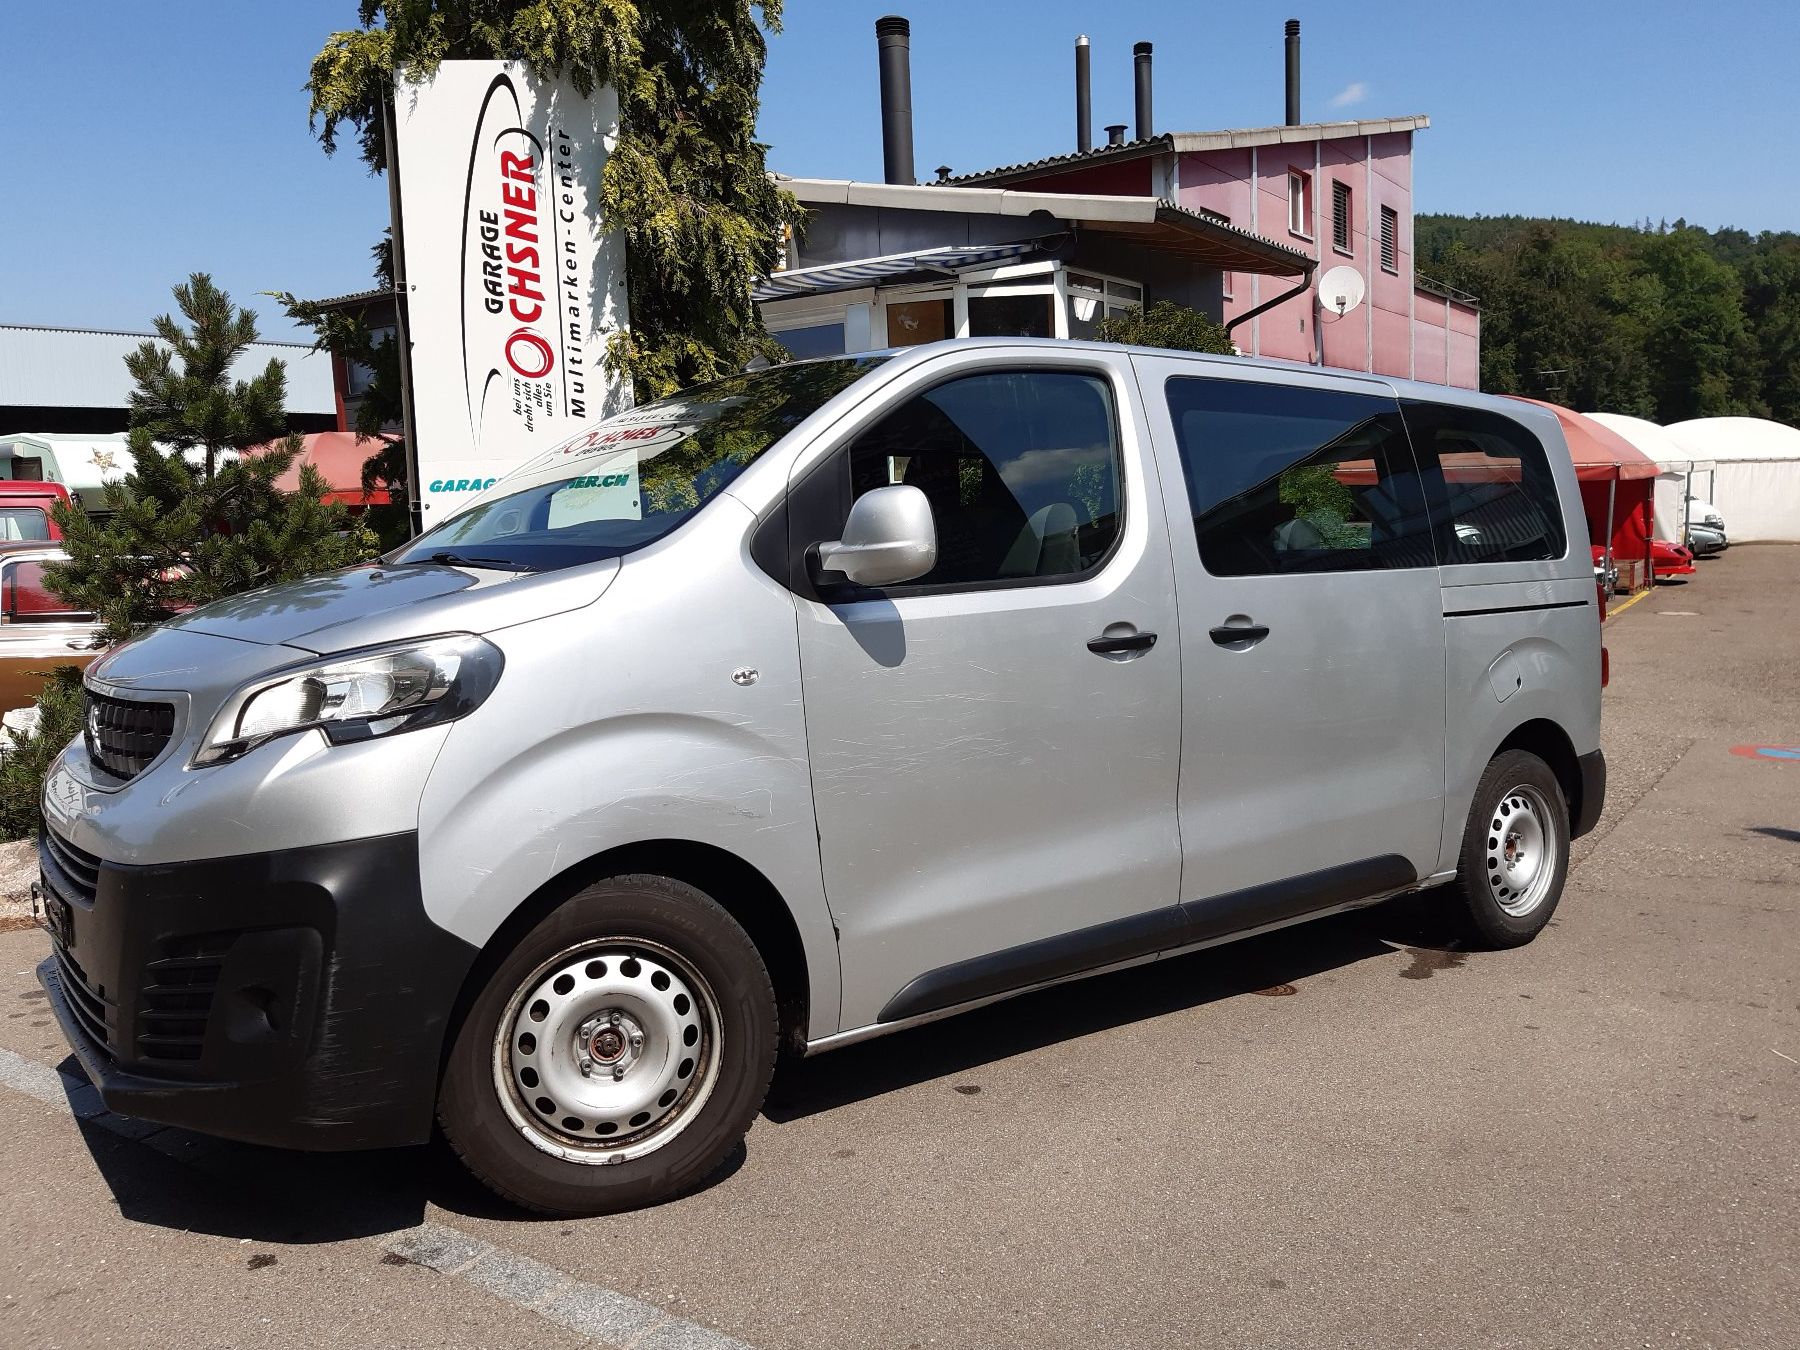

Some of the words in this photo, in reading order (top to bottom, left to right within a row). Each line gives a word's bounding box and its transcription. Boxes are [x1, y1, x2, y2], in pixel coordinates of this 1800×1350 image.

[479, 209, 505, 314] GARAGE
[557, 129, 587, 419] Multimarken-Center
[513, 377, 521, 397] uns
[522, 381, 532, 402] sich
[532, 383, 543, 408] alles
[543, 382, 553, 399] Sie
[512, 397, 522, 416] bei
[546, 400, 553, 417] um
[523, 403, 534, 433] dreht
